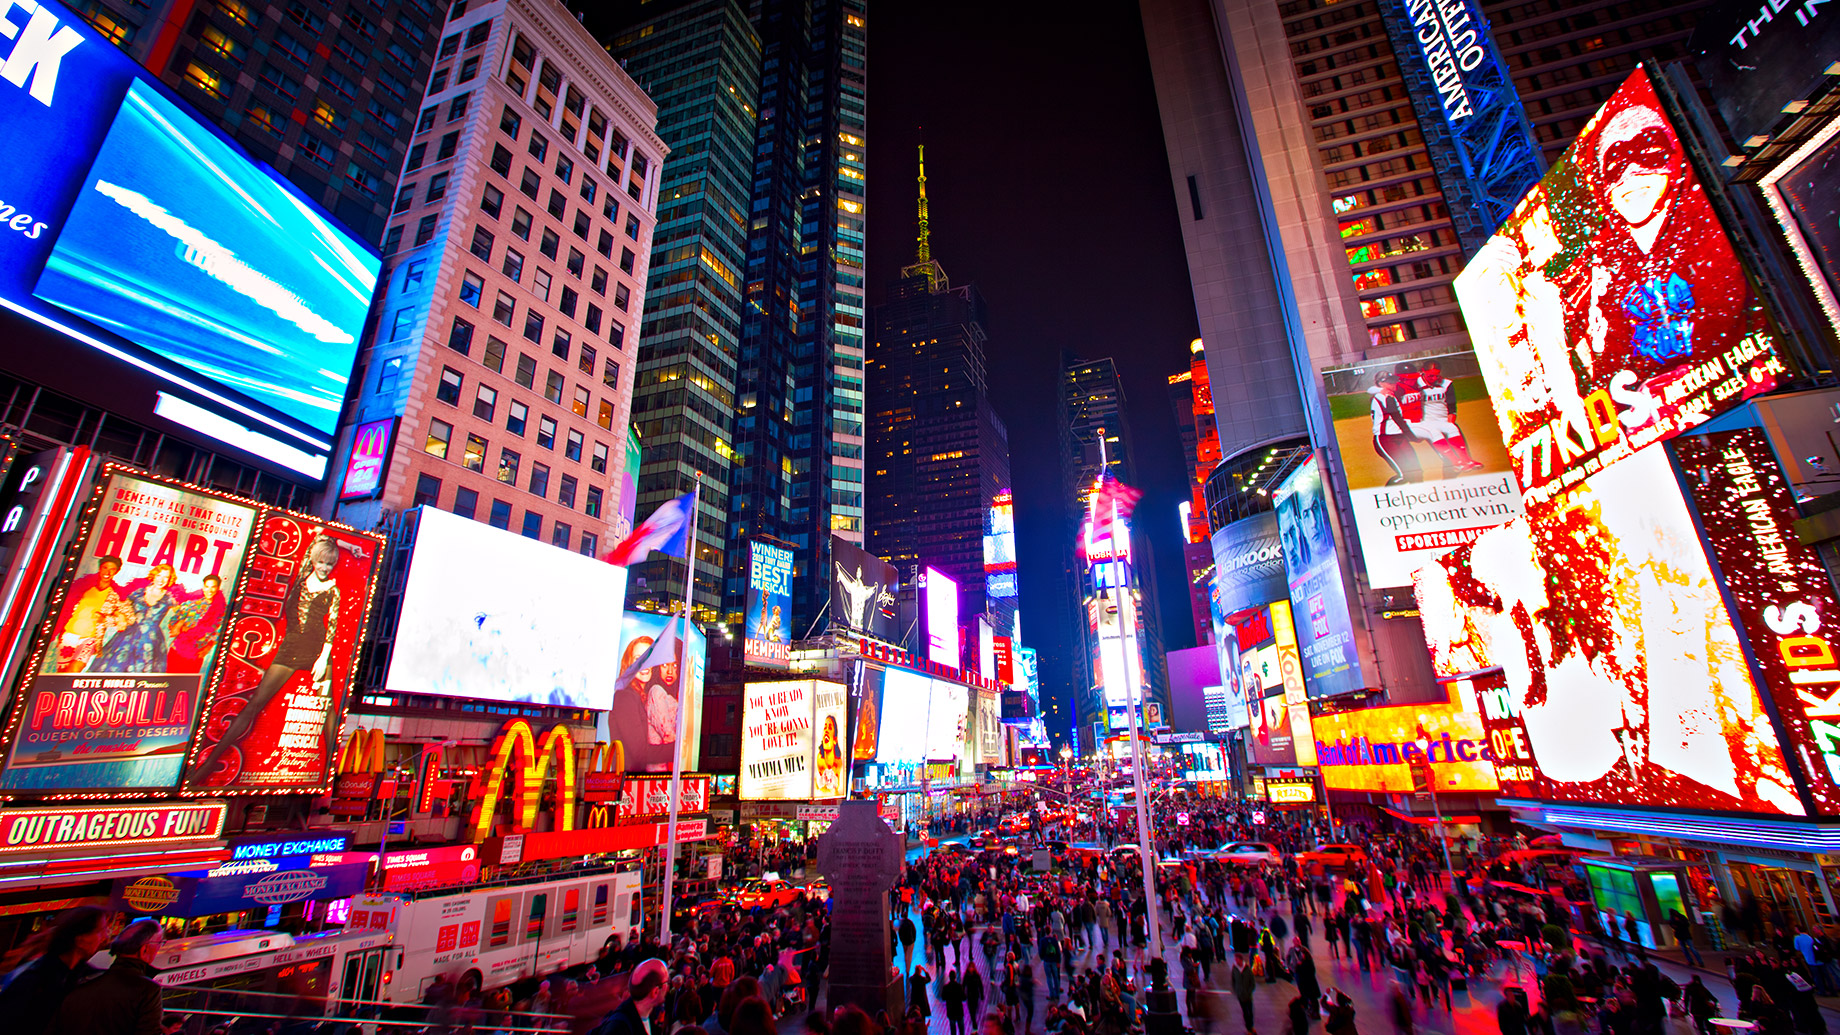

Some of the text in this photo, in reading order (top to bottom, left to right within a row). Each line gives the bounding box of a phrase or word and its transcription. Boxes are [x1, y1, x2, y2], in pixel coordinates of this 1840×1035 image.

[1663, 356, 1727, 405] AMERICAN
[1722, 331, 1772, 370] EAGLE
[1713, 373, 1748, 401] SIZES
[354, 457, 380, 470] OPEN
[1722, 447, 1763, 497] EAGLE
[353, 467, 374, 483] 24
[1373, 487, 1441, 510] Helped
[1442, 477, 1512, 503] injured
[111, 501, 141, 517] BEATS
[143, 510, 150, 518] A
[152, 511, 181, 527] GREAT
[181, 518, 197, 530] BIG
[167, 501, 186, 515] ALL
[188, 505, 214, 521] THAT
[215, 512, 243, 528] GLITZ
[1379, 499, 1516, 531] opponent win.
[1398, 526, 1496, 550] SPORTSMANS
[1741, 498, 1797, 577] AMERICAN
[750, 541, 793, 562] WINNER!
[1087, 549, 1128, 560] TOSHA
[751, 561, 791, 586] BEST
[750, 578, 791, 597] MUSICAL
[1308, 594, 1324, 614] UFC
[1237, 611, 1270, 651] Kodak
[1313, 616, 1329, 638] FOX
[744, 638, 792, 661] MEMPHIS
[1313, 633, 1342, 654] NOVEMBER
[1342, 631, 1350, 643] 12
[1311, 645, 1346, 668] LIVE ON FOX
[72, 679, 103, 690] BETTE
[103, 679, 136, 690] MIDLER
[1279, 643, 1307, 722] Kodak
[31, 689, 189, 731] PRISCILLA
[749, 688, 804, 710] YOU ALREADY
[765, 704, 790, 722] KNOW
[28, 725, 187, 744] QUEEN OF THE DESERT
[281, 721, 325, 736] AMERICAN
[748, 716, 809, 739] YOU'RE GONNA
[72, 738, 142, 755] the musical
[277, 733, 320, 749] MUSICAL
[762, 731, 798, 752] LOVE IT!
[1316, 738, 1347, 767] Bank
[1346, 737, 1358, 765] of
[1360, 731, 1492, 766] America
[749, 754, 805, 780] MAMMA MIA!
[586, 778, 620, 786] McDonald's
[7, 809, 211, 845] OUTRAGEOUS FUN!
[234, 837, 346, 859] MONEY EXCHANGE
[386, 852, 428, 864] TIMES SQUARE
[125, 887, 180, 901] MONEY EXCHANGE
[243, 877, 328, 897] MONEY EXCHANGE
[461, 935, 477, 944] QLO
[463, 925, 478, 934] UNI
[273, 952, 293, 964] HELL
[305, 944, 338, 958] WHEELS
[452, 953, 464, 961] FOR
[464, 950, 476, 958] ALL
[167, 968, 207, 984] WHEELS
